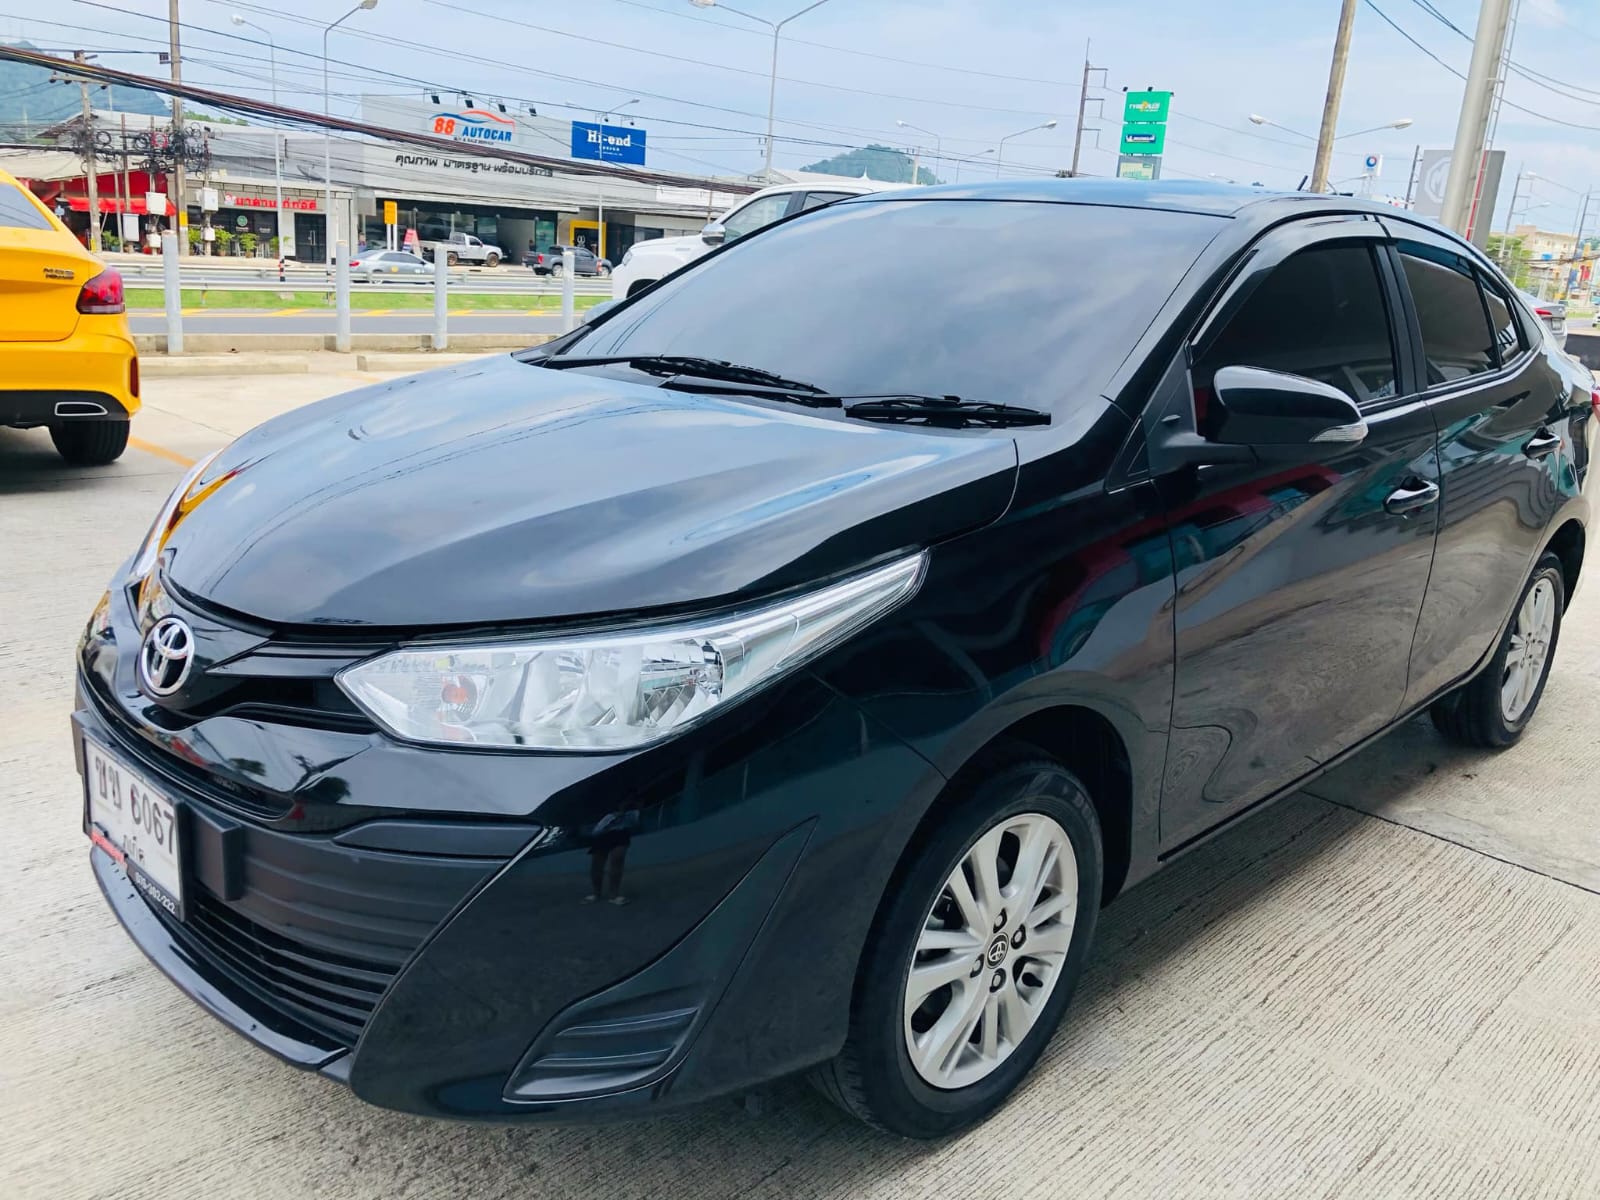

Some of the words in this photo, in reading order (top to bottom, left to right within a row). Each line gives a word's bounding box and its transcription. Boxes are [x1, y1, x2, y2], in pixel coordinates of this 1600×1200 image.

[433, 117, 456, 135] 88
[462, 126, 512, 142] AUTOCAR
[587, 129, 631, 147] Hi-end
[395, 154, 438, 168] คุณภาพ
[130, 782, 175, 855] 6067
